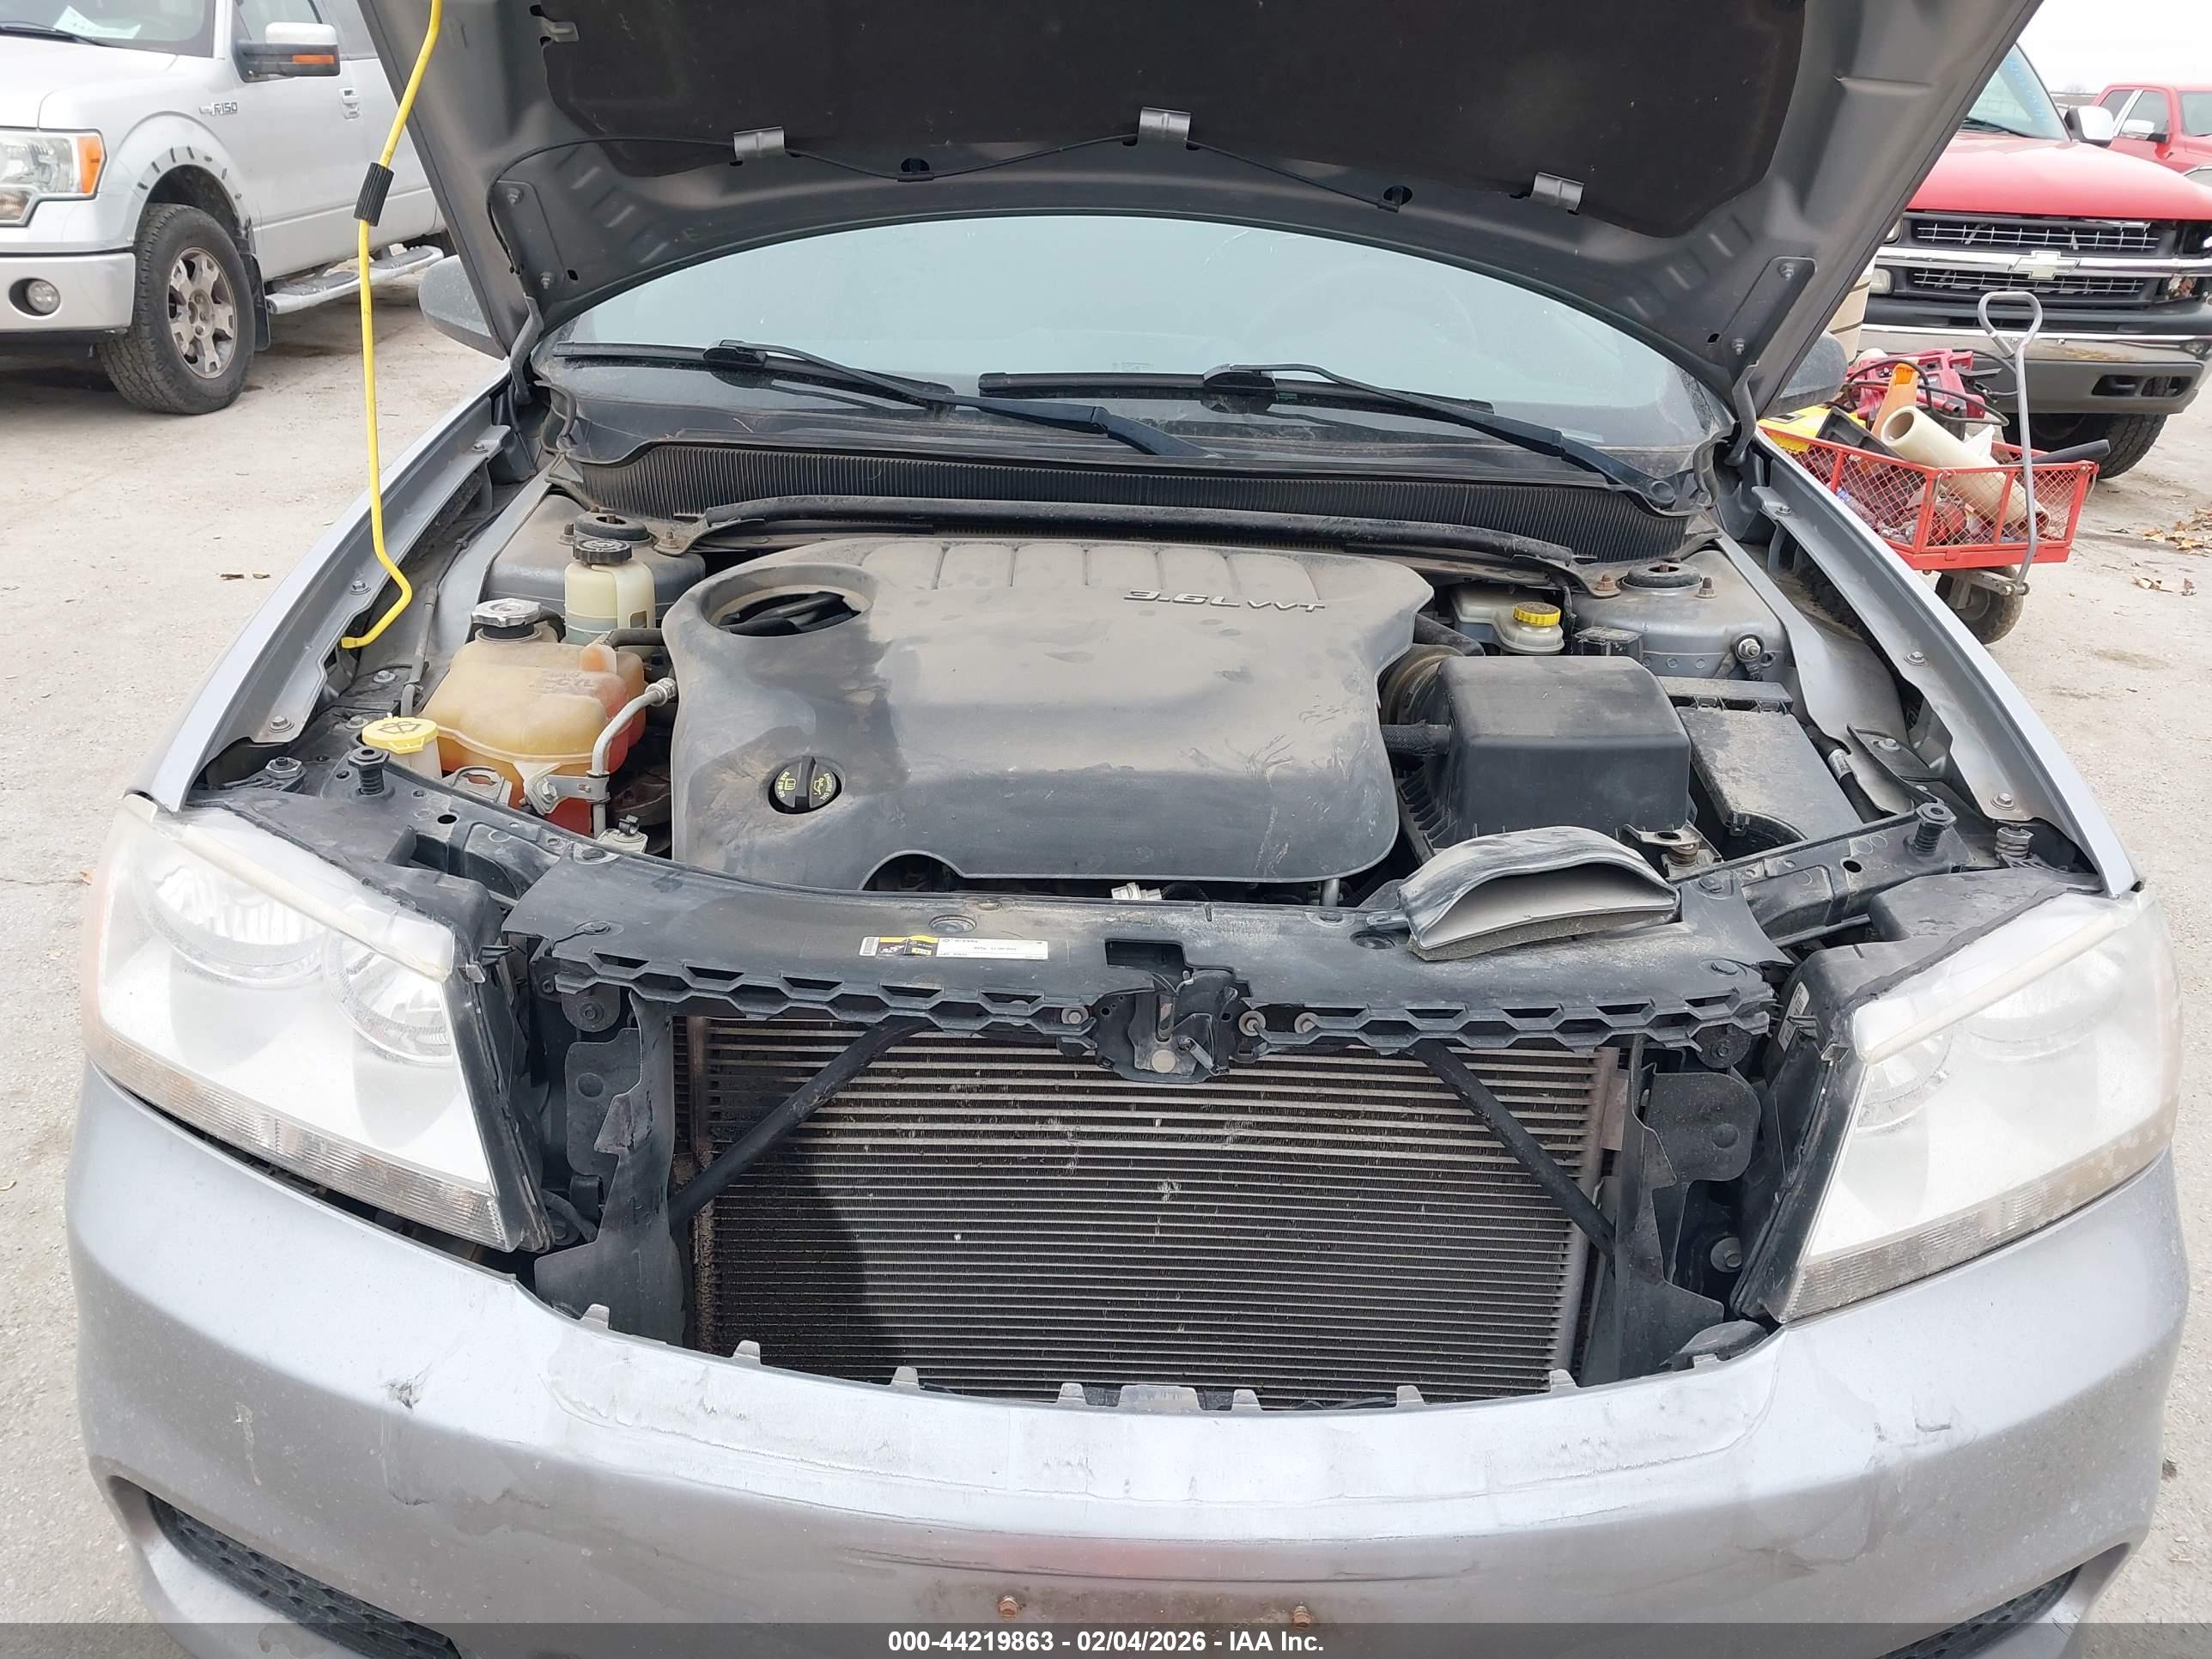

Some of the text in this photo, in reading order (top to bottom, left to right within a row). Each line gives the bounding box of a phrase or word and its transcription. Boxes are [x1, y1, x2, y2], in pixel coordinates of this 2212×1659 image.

[1123, 589, 1326, 613] 3.6L VVT
[819, 773, 833, 800] ENGINE OIL
